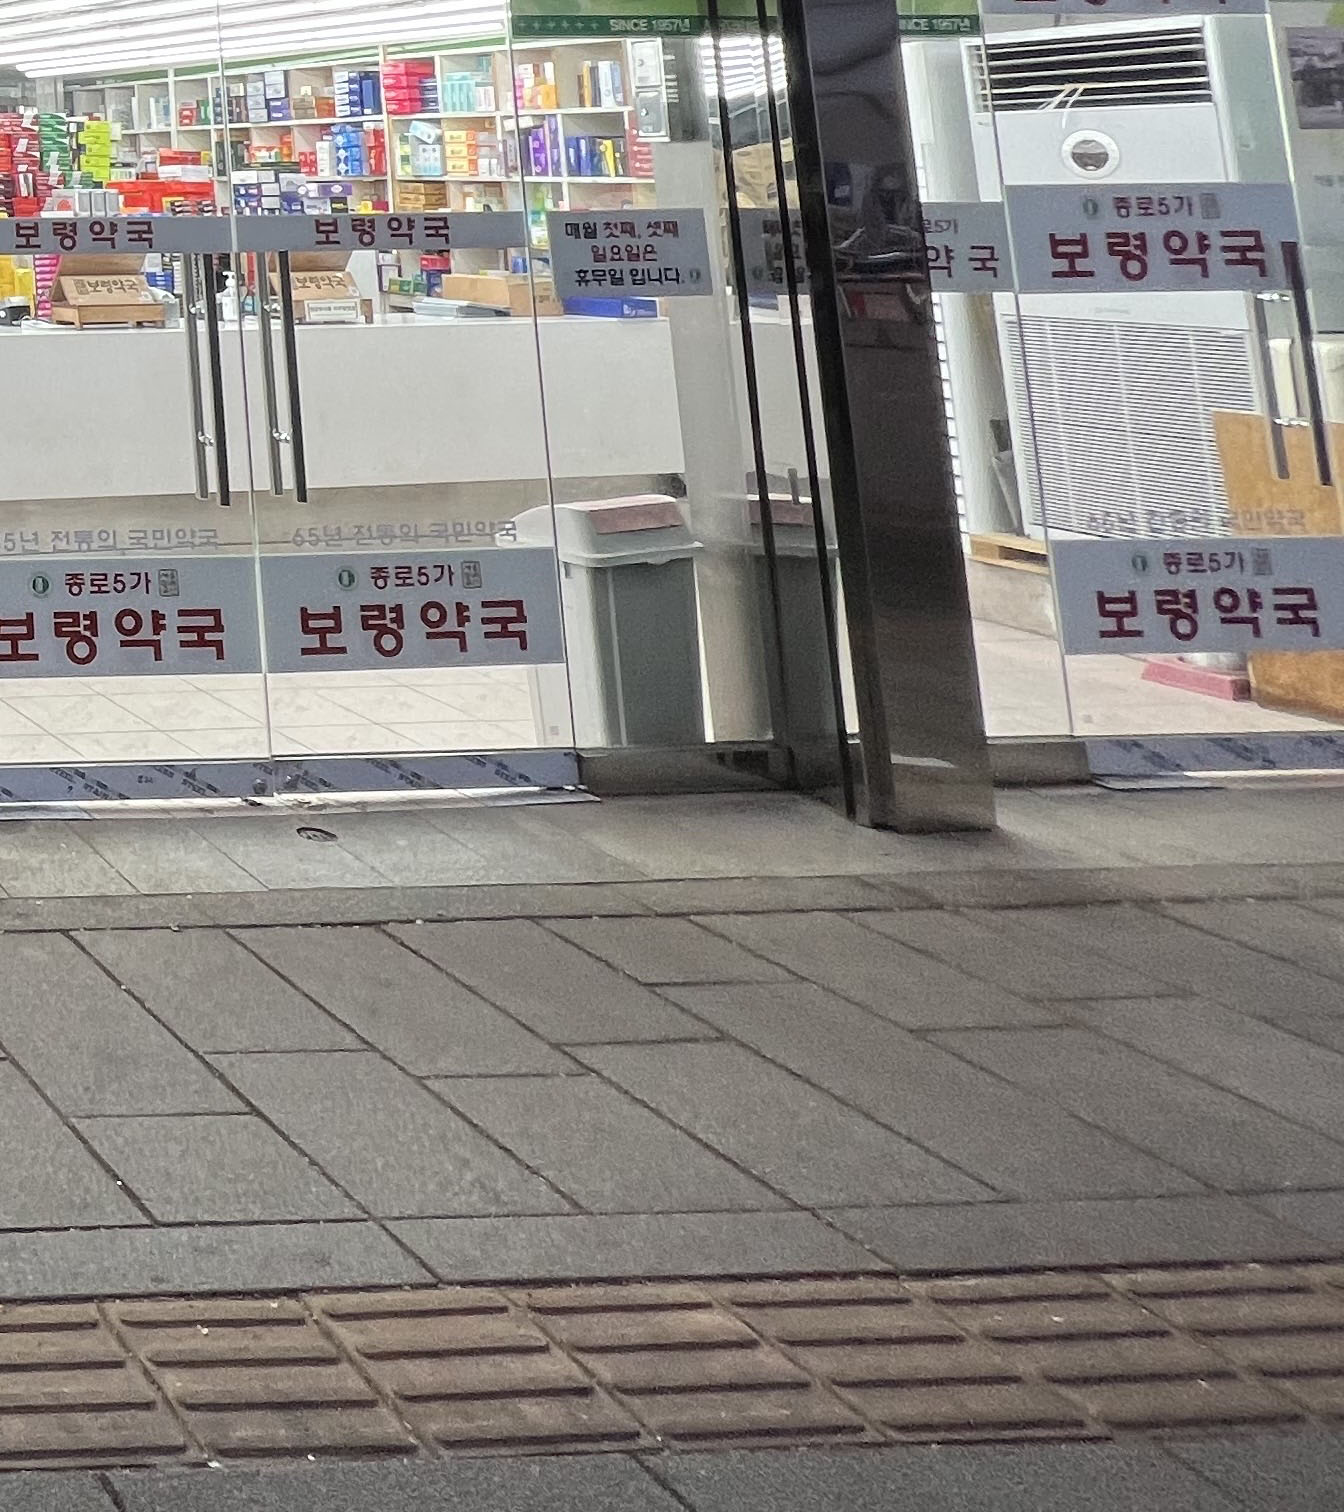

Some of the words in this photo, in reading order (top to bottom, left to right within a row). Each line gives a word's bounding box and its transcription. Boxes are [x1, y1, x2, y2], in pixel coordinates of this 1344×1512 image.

[609, 19, 649, 32] SINCE
[1112, 196, 1194, 218] 종로5가
[14, 219, 154, 250] 보령약국
[313, 216, 451, 247] 보령약국
[565, 222, 598, 239] 매월
[647, 220, 678, 238] 셋째
[591, 244, 658, 263] 일요일은
[1049, 229, 1268, 282] 보령약국
[87, 277, 138, 293] 보령약국
[574, 268, 624, 287] 휴무일
[50, 530, 119, 554] 전통의
[128, 528, 220, 552] 국민약국
[291, 526, 343, 548] 65년
[353, 524, 419, 547] 전통의
[429, 520, 518, 544] 국민약국
[1164, 551, 1244, 575] 종로5가
[64, 571, 152, 597] 종로5가
[369, 564, 455, 589] 종로5가
[1096, 587, 1321, 642] 보령약국
[299, 599, 528, 658] 보령약국
